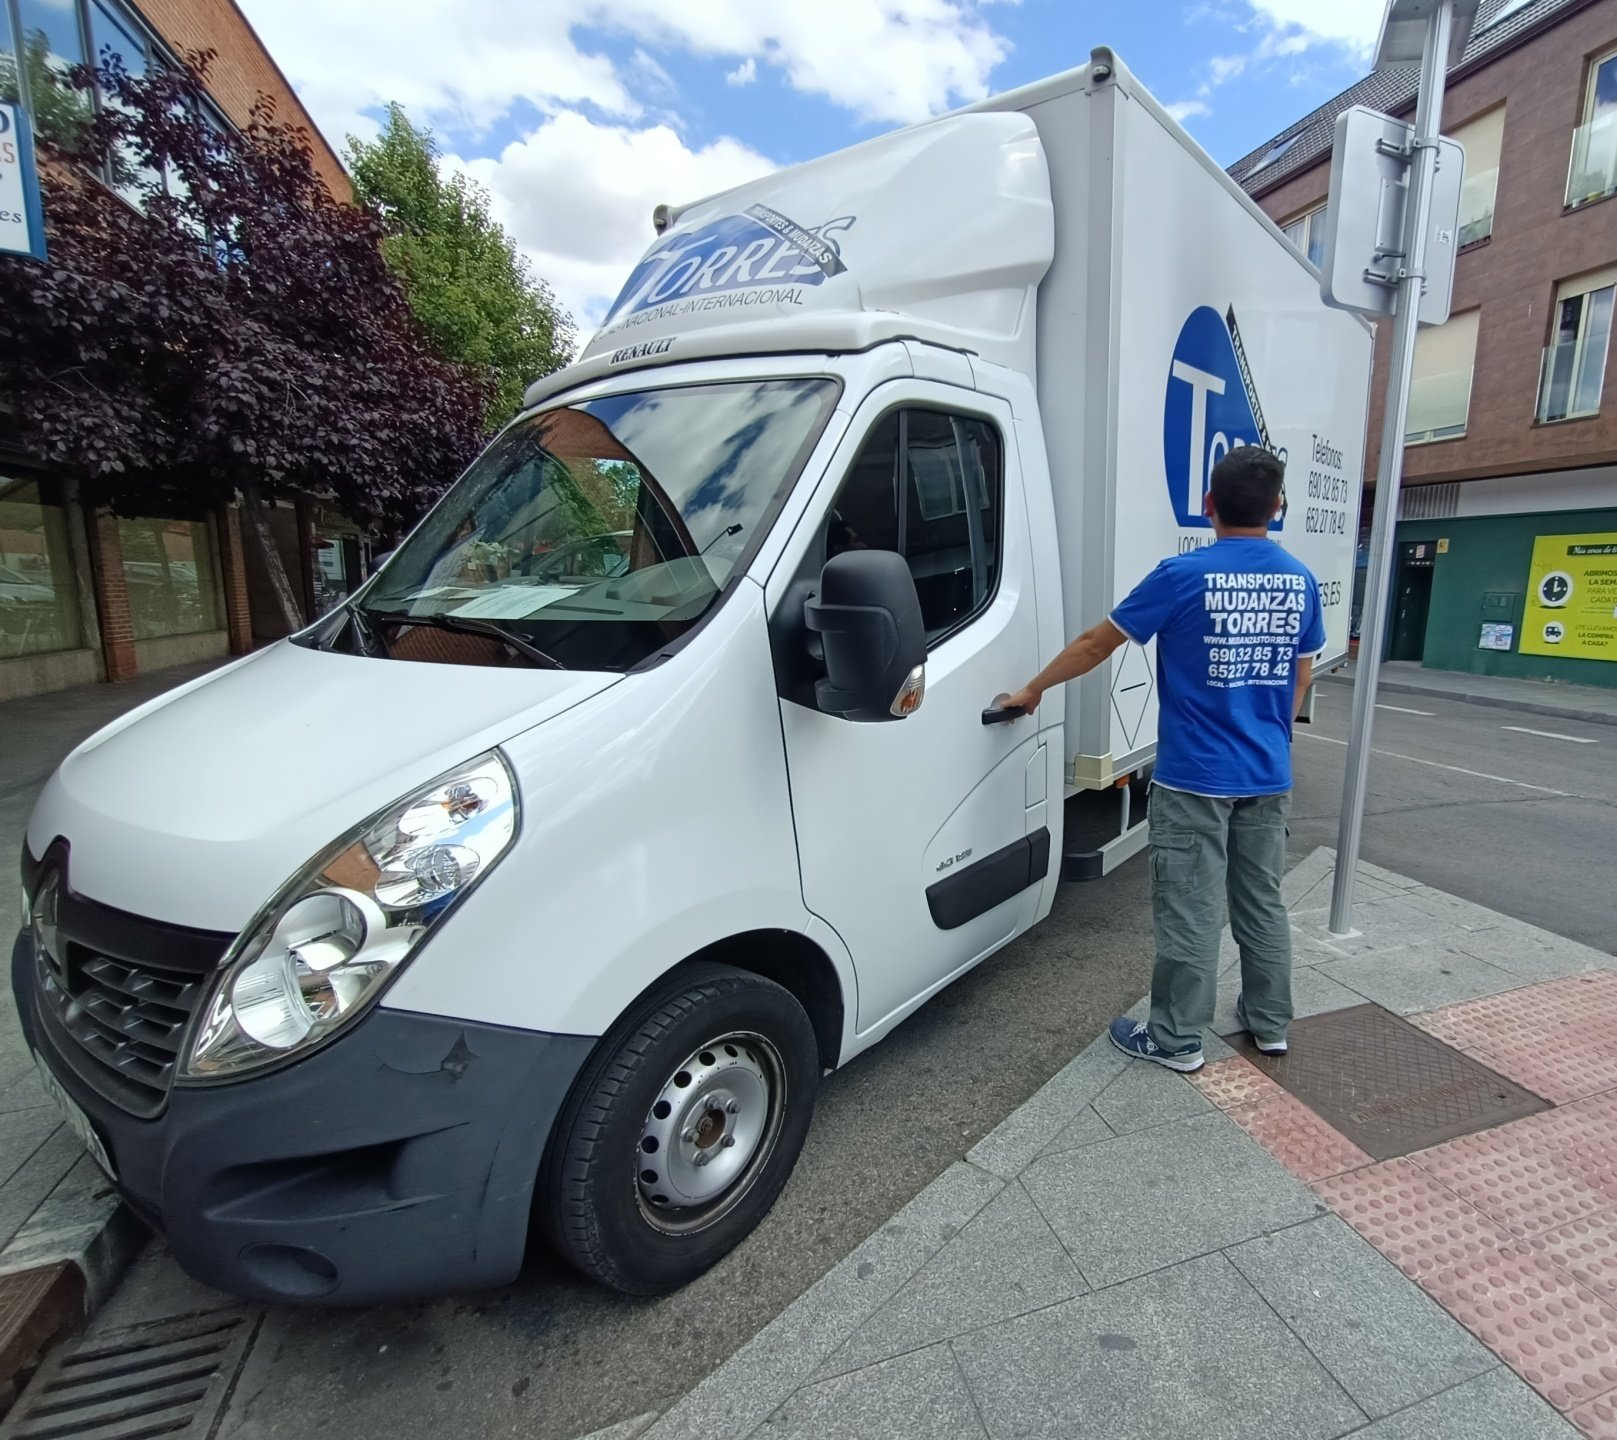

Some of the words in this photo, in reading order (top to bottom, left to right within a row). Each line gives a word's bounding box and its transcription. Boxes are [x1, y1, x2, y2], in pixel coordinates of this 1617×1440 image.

[610, 336, 678, 364] RENAULT
[1308, 471, 1321, 499] 690
[1322, 474, 1331, 500] 32
[1331, 477, 1339, 502] 85
[1340, 480, 1348, 504] 73
[1306, 507, 1319, 533] 652
[1320, 508, 1329, 533] 27
[1329, 510, 1337, 534] 78
[1338, 512, 1346, 535] 42
[1204, 573, 1306, 591] TRANSPORTES
[1205, 591, 1305, 612] MUDANZAS
[1210, 612, 1300, 634] TORRES
[1253, 646, 1273, 660] 85
[1277, 647, 1293, 661] 73
[1251, 662, 1270, 676] 78
[1273, 662, 1290, 676] 42
